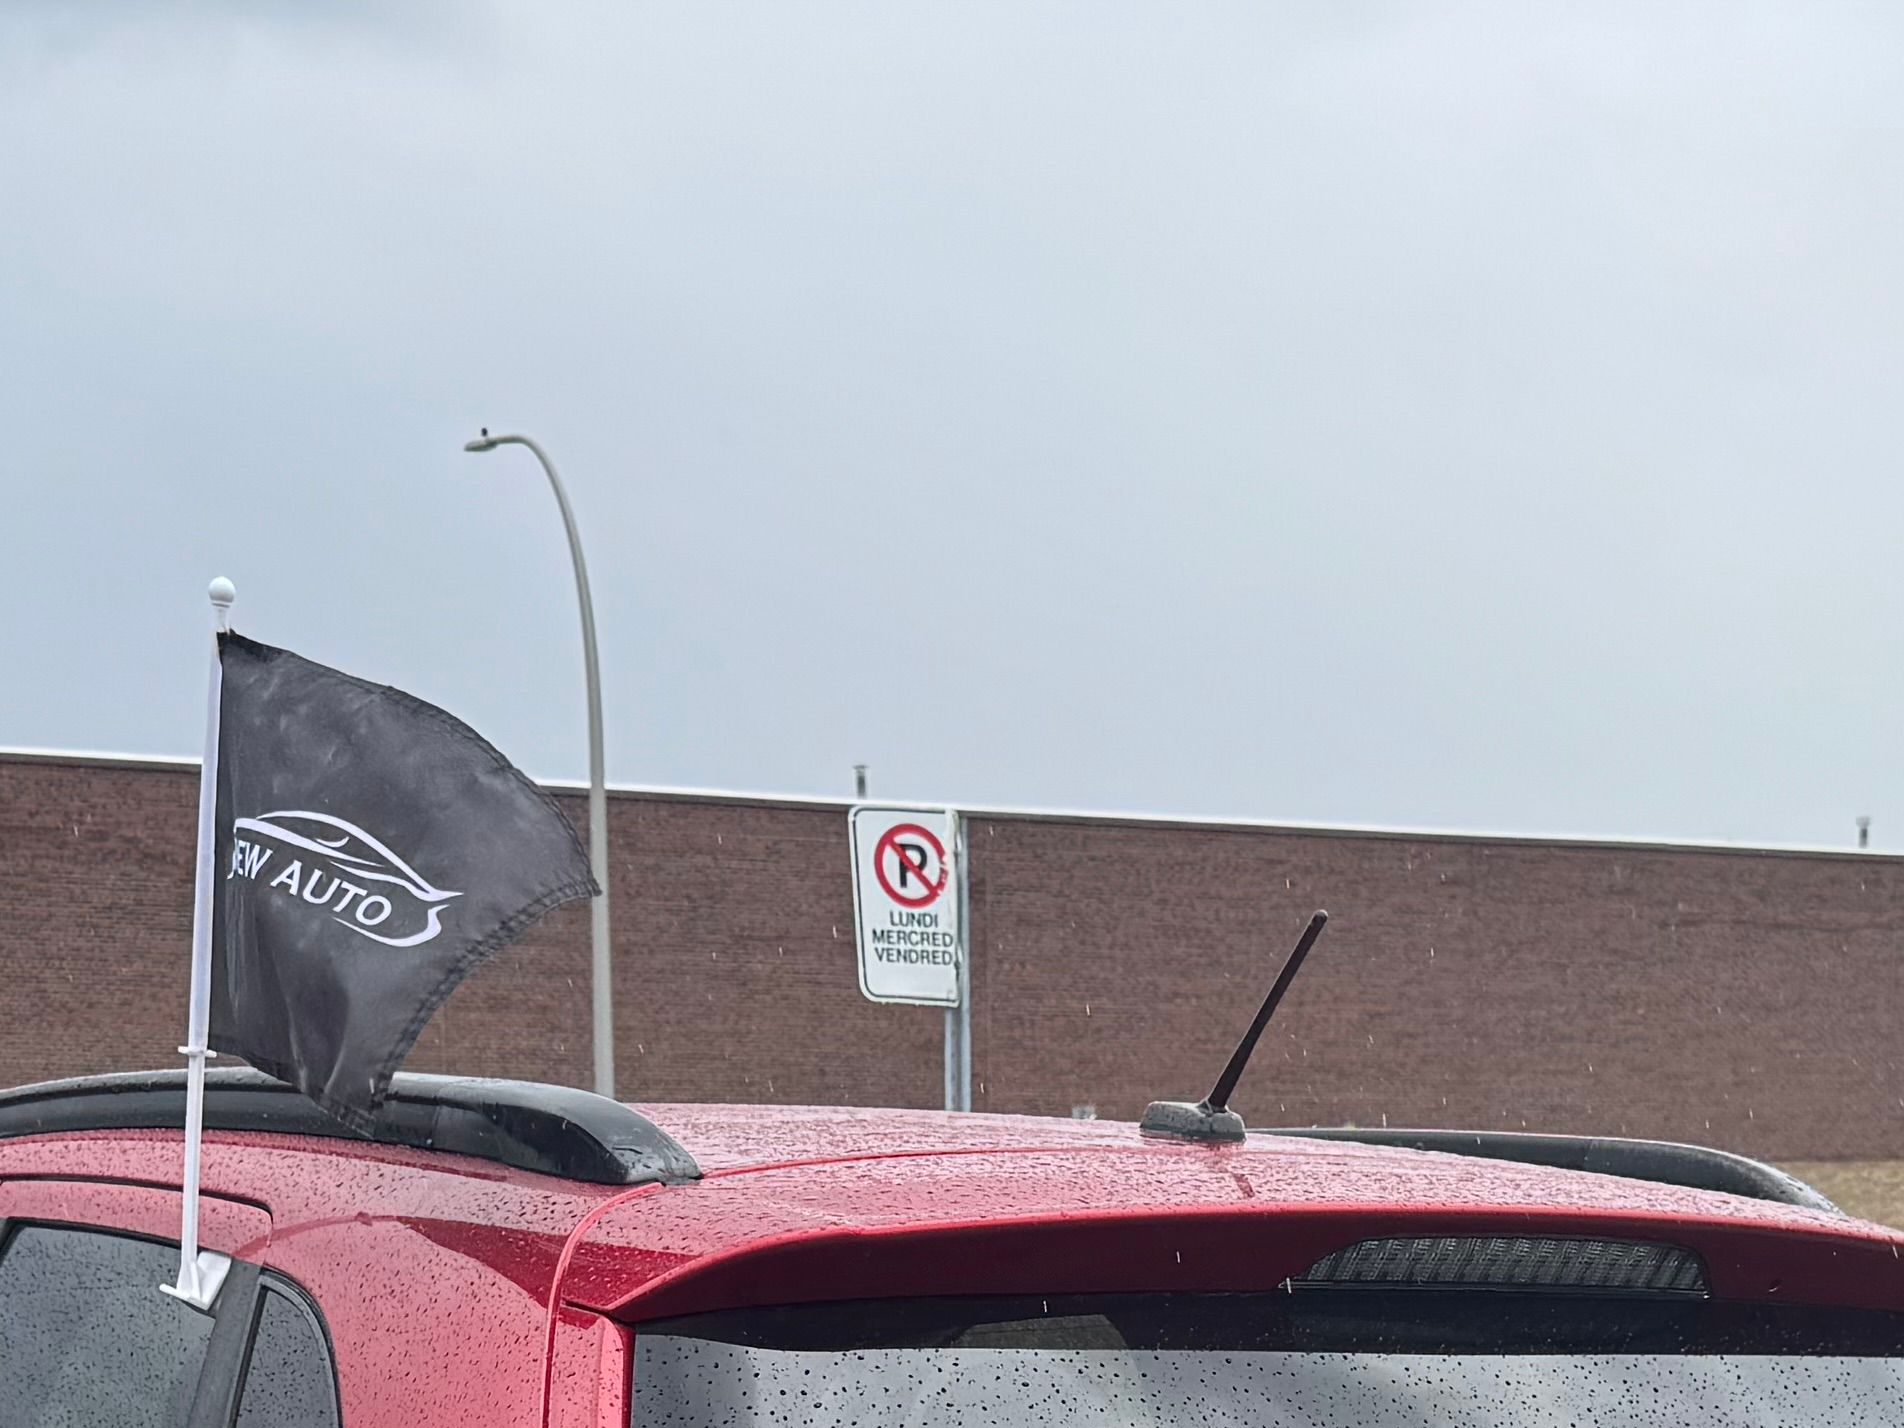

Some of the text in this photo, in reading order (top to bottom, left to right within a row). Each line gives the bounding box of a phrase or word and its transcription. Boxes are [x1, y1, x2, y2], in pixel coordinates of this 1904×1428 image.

[270, 860, 392, 926] AUTO
[889, 911, 939, 928] LUNDI
[871, 930, 954, 948] MERCRED
[874, 947, 954, 966] VENDRED
